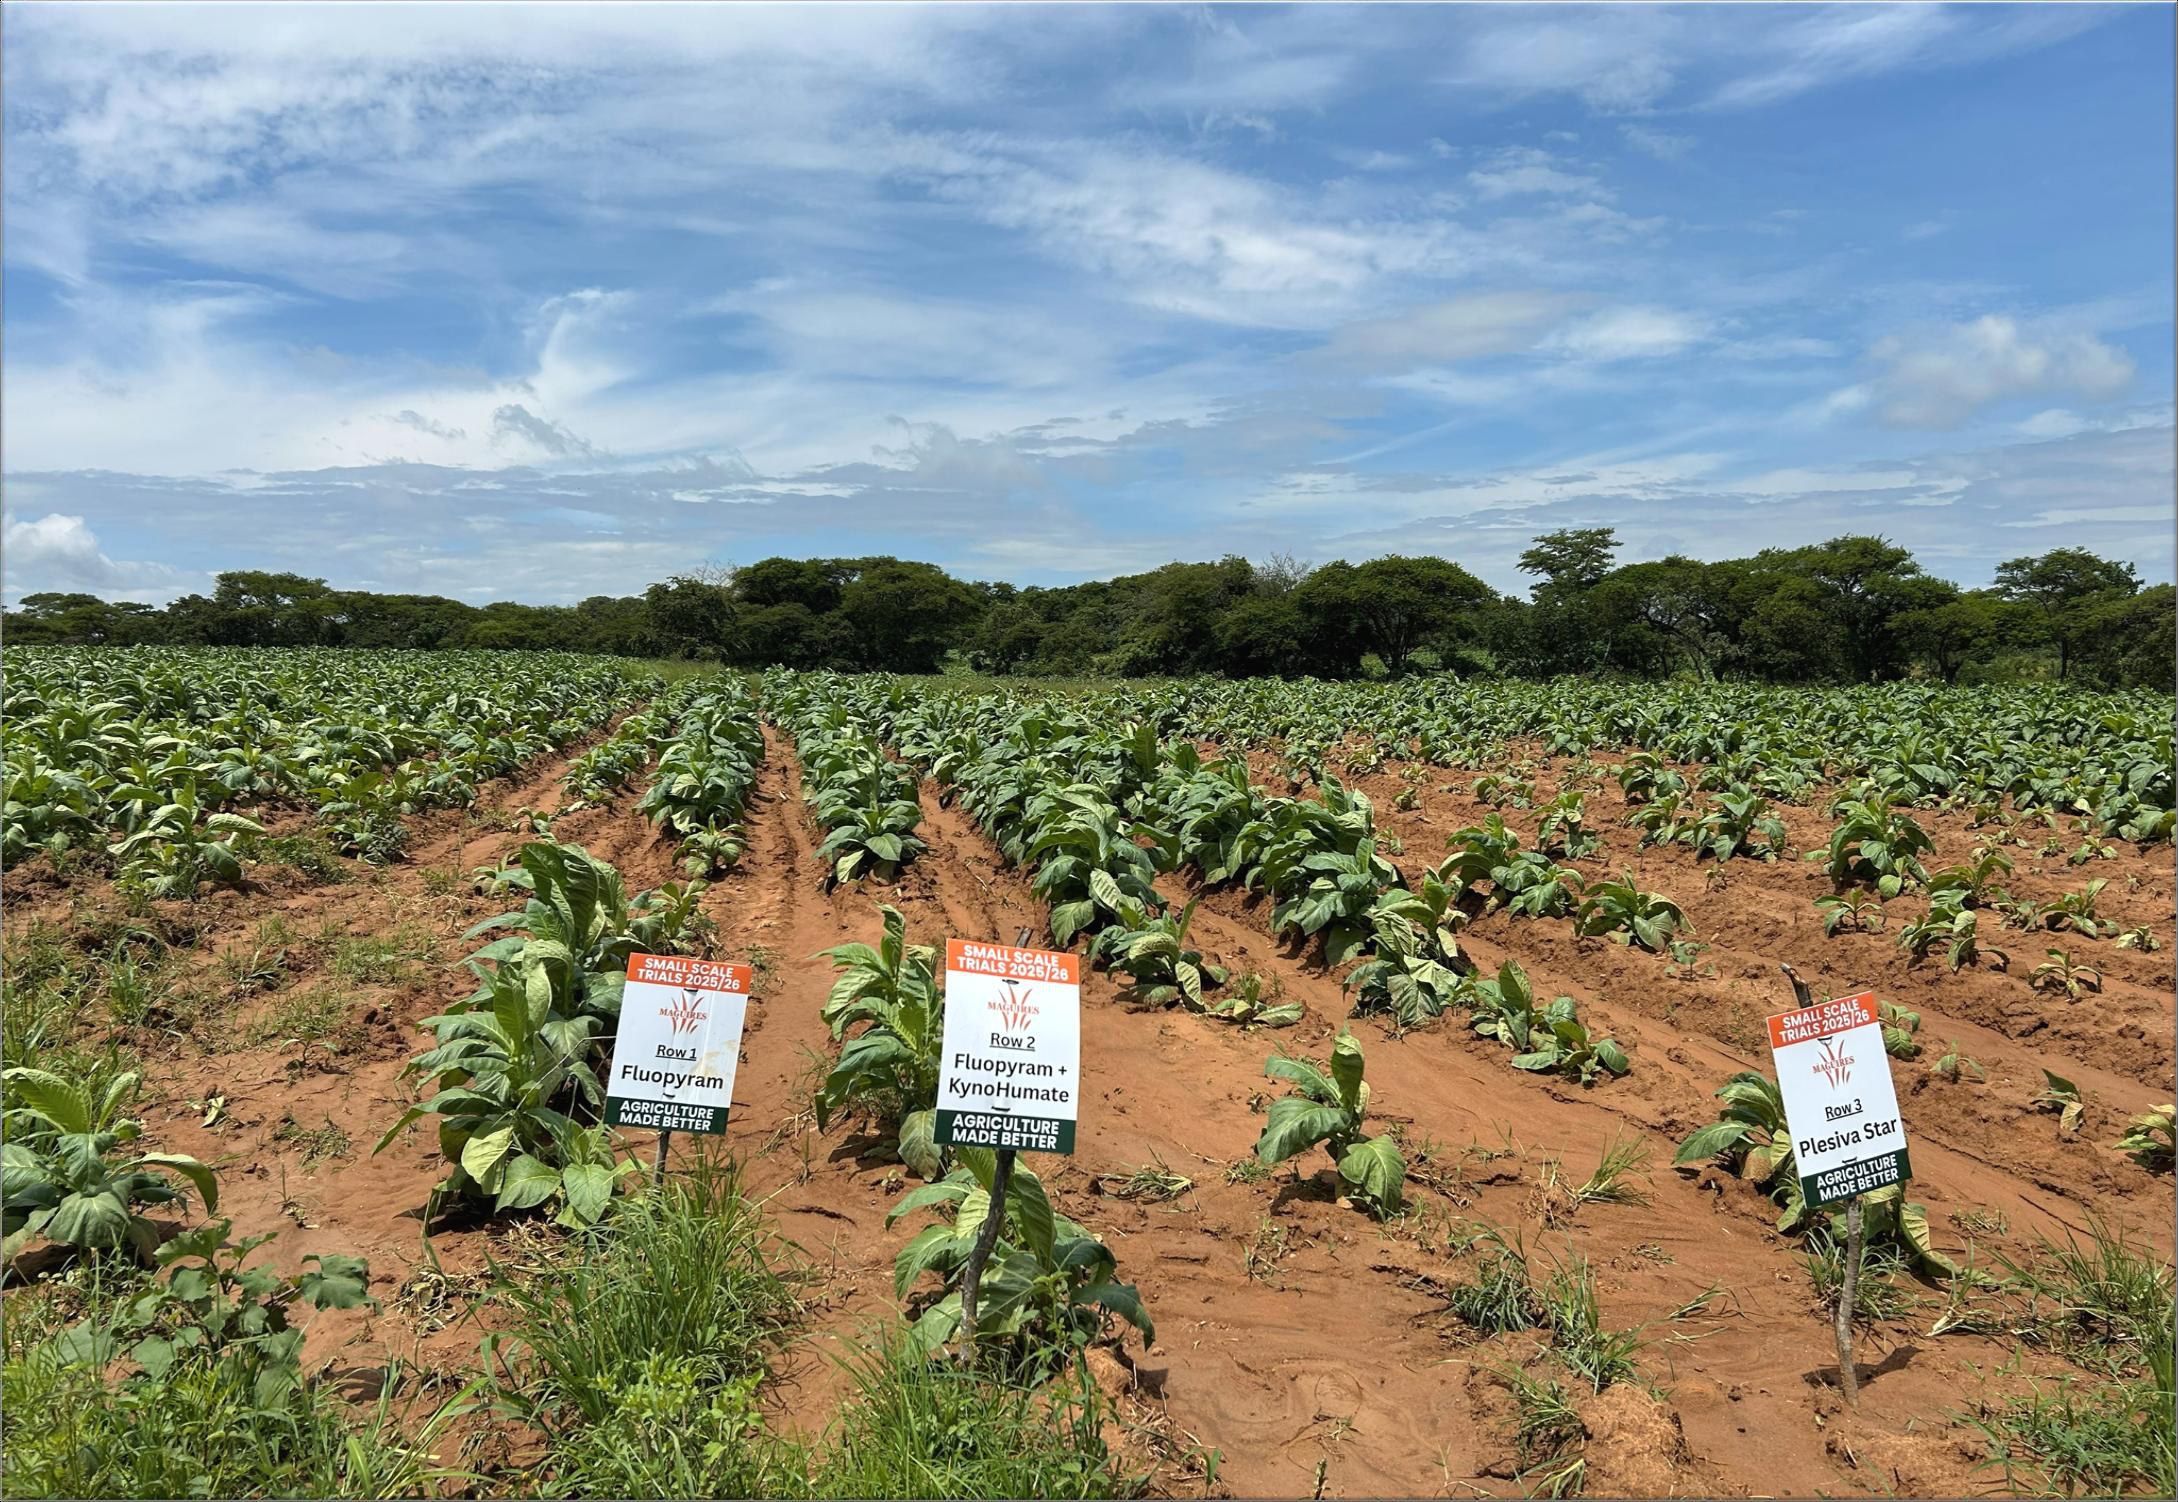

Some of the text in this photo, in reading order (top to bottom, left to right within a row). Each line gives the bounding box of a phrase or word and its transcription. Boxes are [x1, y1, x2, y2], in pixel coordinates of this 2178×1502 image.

[964, 945, 1059, 967] SMALL SCALE
[645, 958, 734, 978] SMALL SCALE
[957, 957, 1068, 981] TRIALS 2025/26
[637, 969, 740, 990] TRIALS 2025/26
[659, 1008, 708, 1021] MAGUIRES
[987, 1001, 1040, 1015] MAGUIRES
[1782, 999, 1860, 1029] SMALL SCALE
[1779, 1009, 1870, 1042] TRIALS 2025/26
[991, 1032, 1035, 1048] Row 2
[657, 1045, 697, 1058] Row 1
[954, 1053, 1067, 1077] Fluopyram +
[1813, 1056, 1855, 1074] MAGUIRES
[621, 1065, 723, 1089] Fluopyram
[949, 1078, 1069, 1103] KynoHumate
[620, 1100, 714, 1120] AGRICULTURE
[1825, 1099, 1862, 1119] Row 3
[620, 1113, 711, 1131] MADE BETTER
[952, 1114, 1060, 1135] AGRICULTURE
[952, 1128, 1057, 1149] MADE BETTER
[1799, 1119, 1897, 1158] Plesiva Star
[1817, 1154, 1897, 1188] AGRICULTURE
[1819, 1168, 1899, 1201] MADE BETTER
